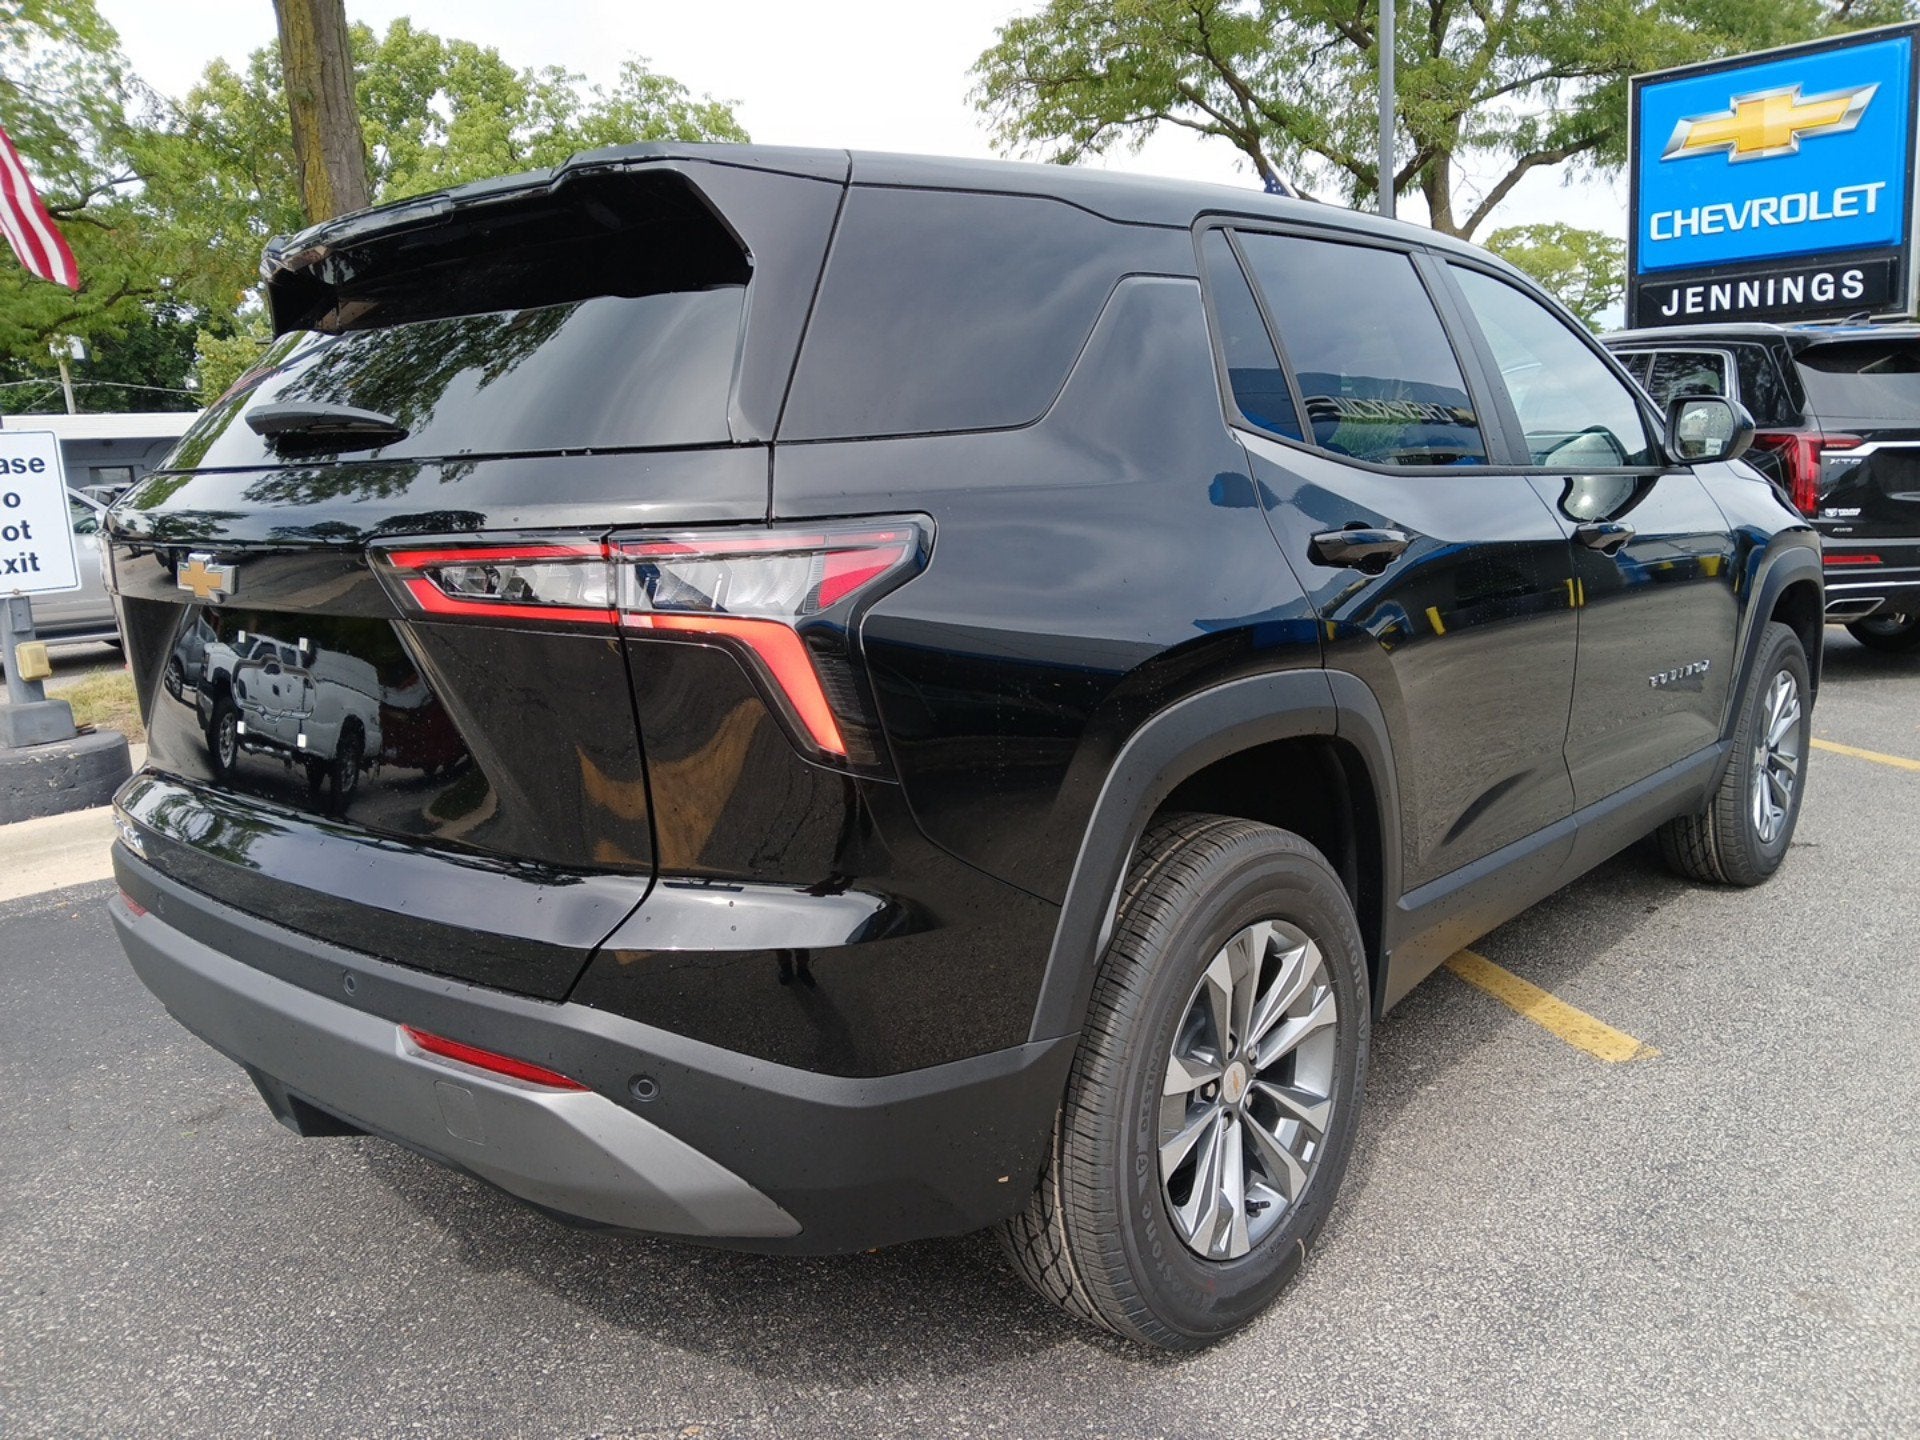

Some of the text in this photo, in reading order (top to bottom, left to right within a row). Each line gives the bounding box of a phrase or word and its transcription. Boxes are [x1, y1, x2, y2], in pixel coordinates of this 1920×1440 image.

[1649, 181, 1886, 242] CHEVROLET
[1661, 269, 1865, 317] JENNINGS
[0, 552, 41, 575] xit
